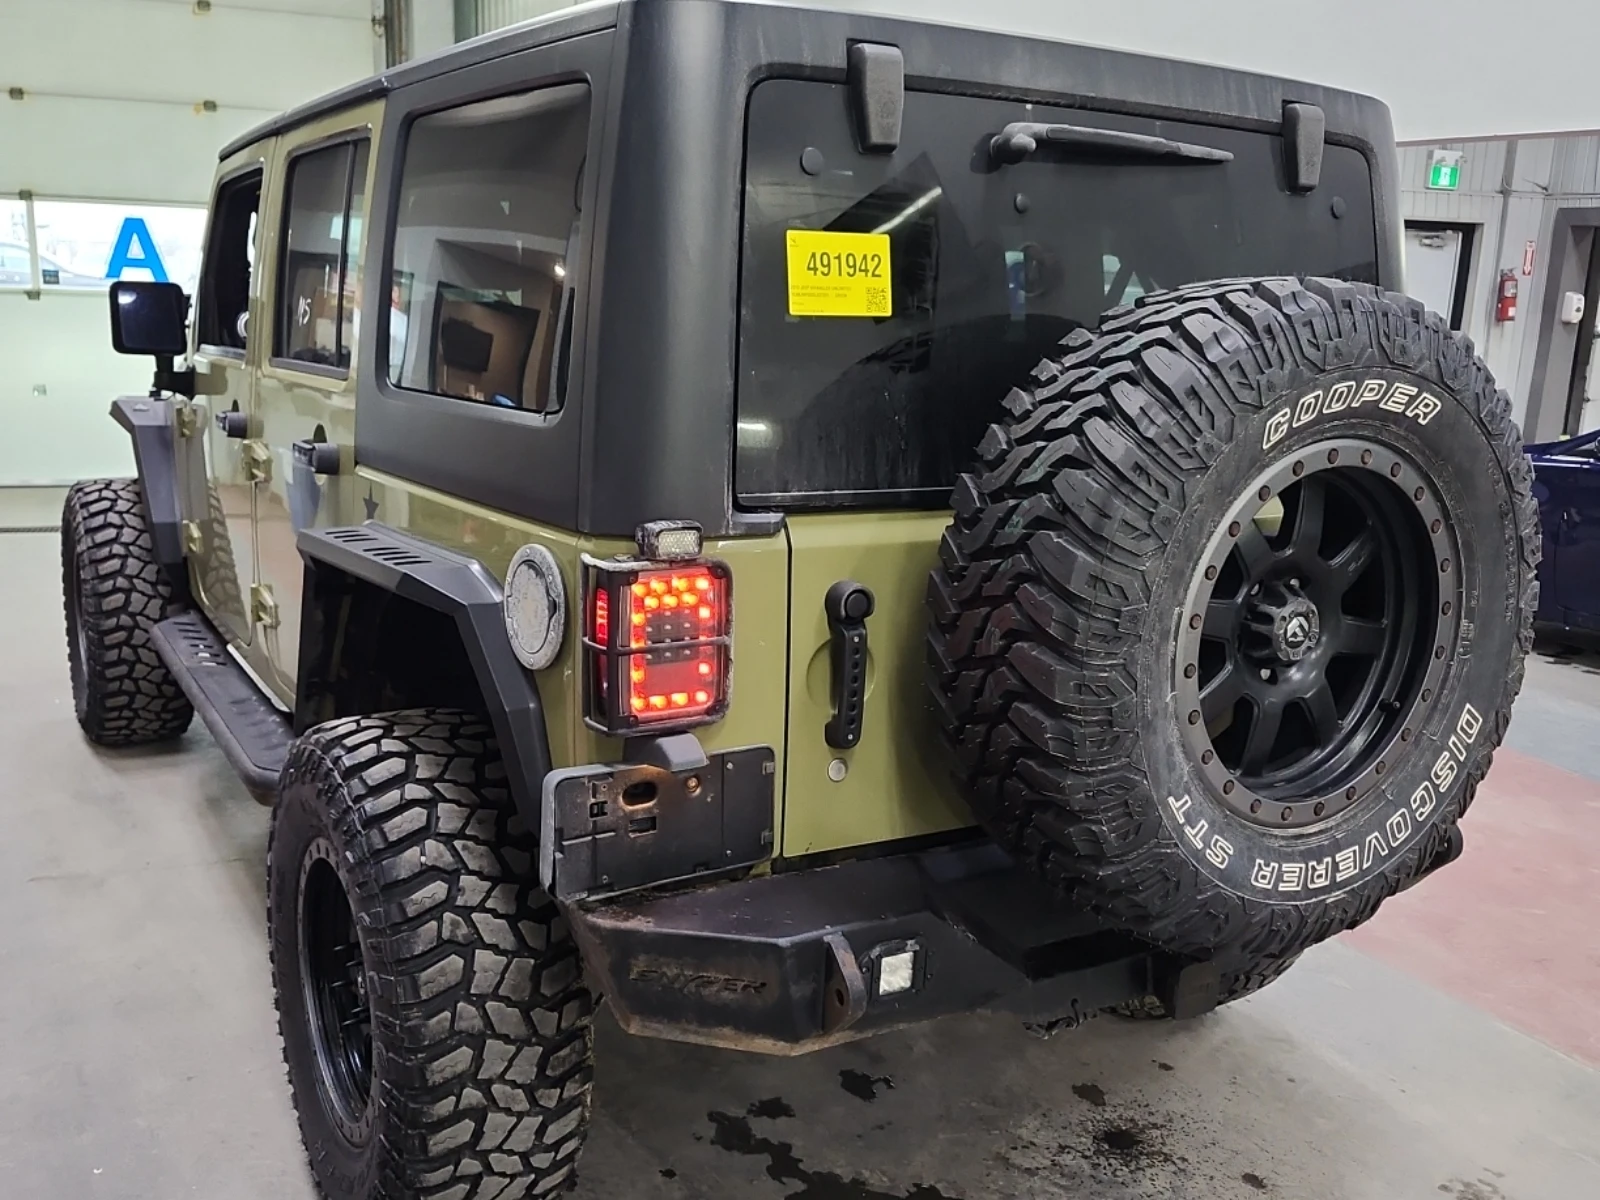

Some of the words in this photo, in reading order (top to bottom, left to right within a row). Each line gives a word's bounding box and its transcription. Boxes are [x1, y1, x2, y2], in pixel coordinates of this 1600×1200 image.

[106, 217, 169, 282] A
[806, 252, 882, 278] 491942
[1262, 380, 1442, 449] COOPER
[1167, 794, 1234, 869] STT
[1251, 703, 1483, 891] DISCOVERER
